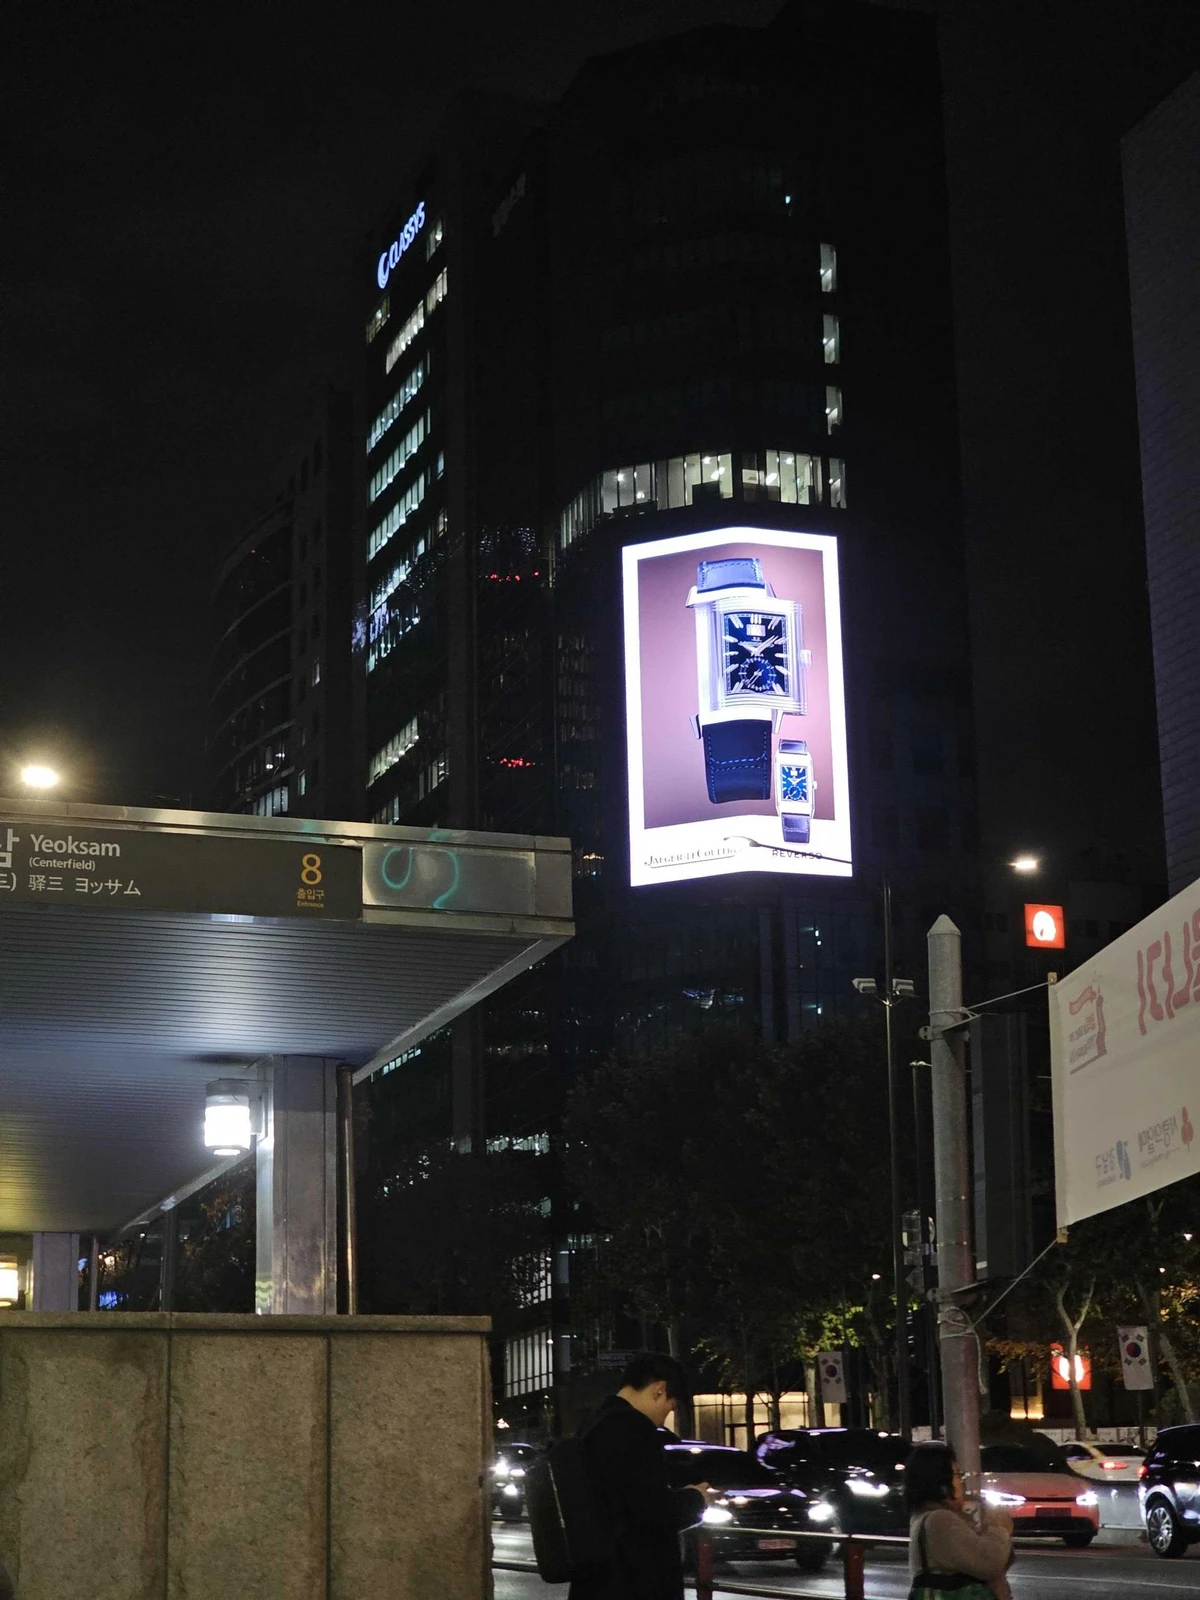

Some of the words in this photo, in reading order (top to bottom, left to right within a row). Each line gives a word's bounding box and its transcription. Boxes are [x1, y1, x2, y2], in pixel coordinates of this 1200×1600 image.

[30, 833, 121, 857] Yeoksam
[772, 849, 823, 860] REVERSO
[29, 856, 96, 872] (Centerfield)
[301, 853, 322, 885] 8
[75, 877, 141, 896] ヨッサム
[297, 887, 325, 900] 출입구
